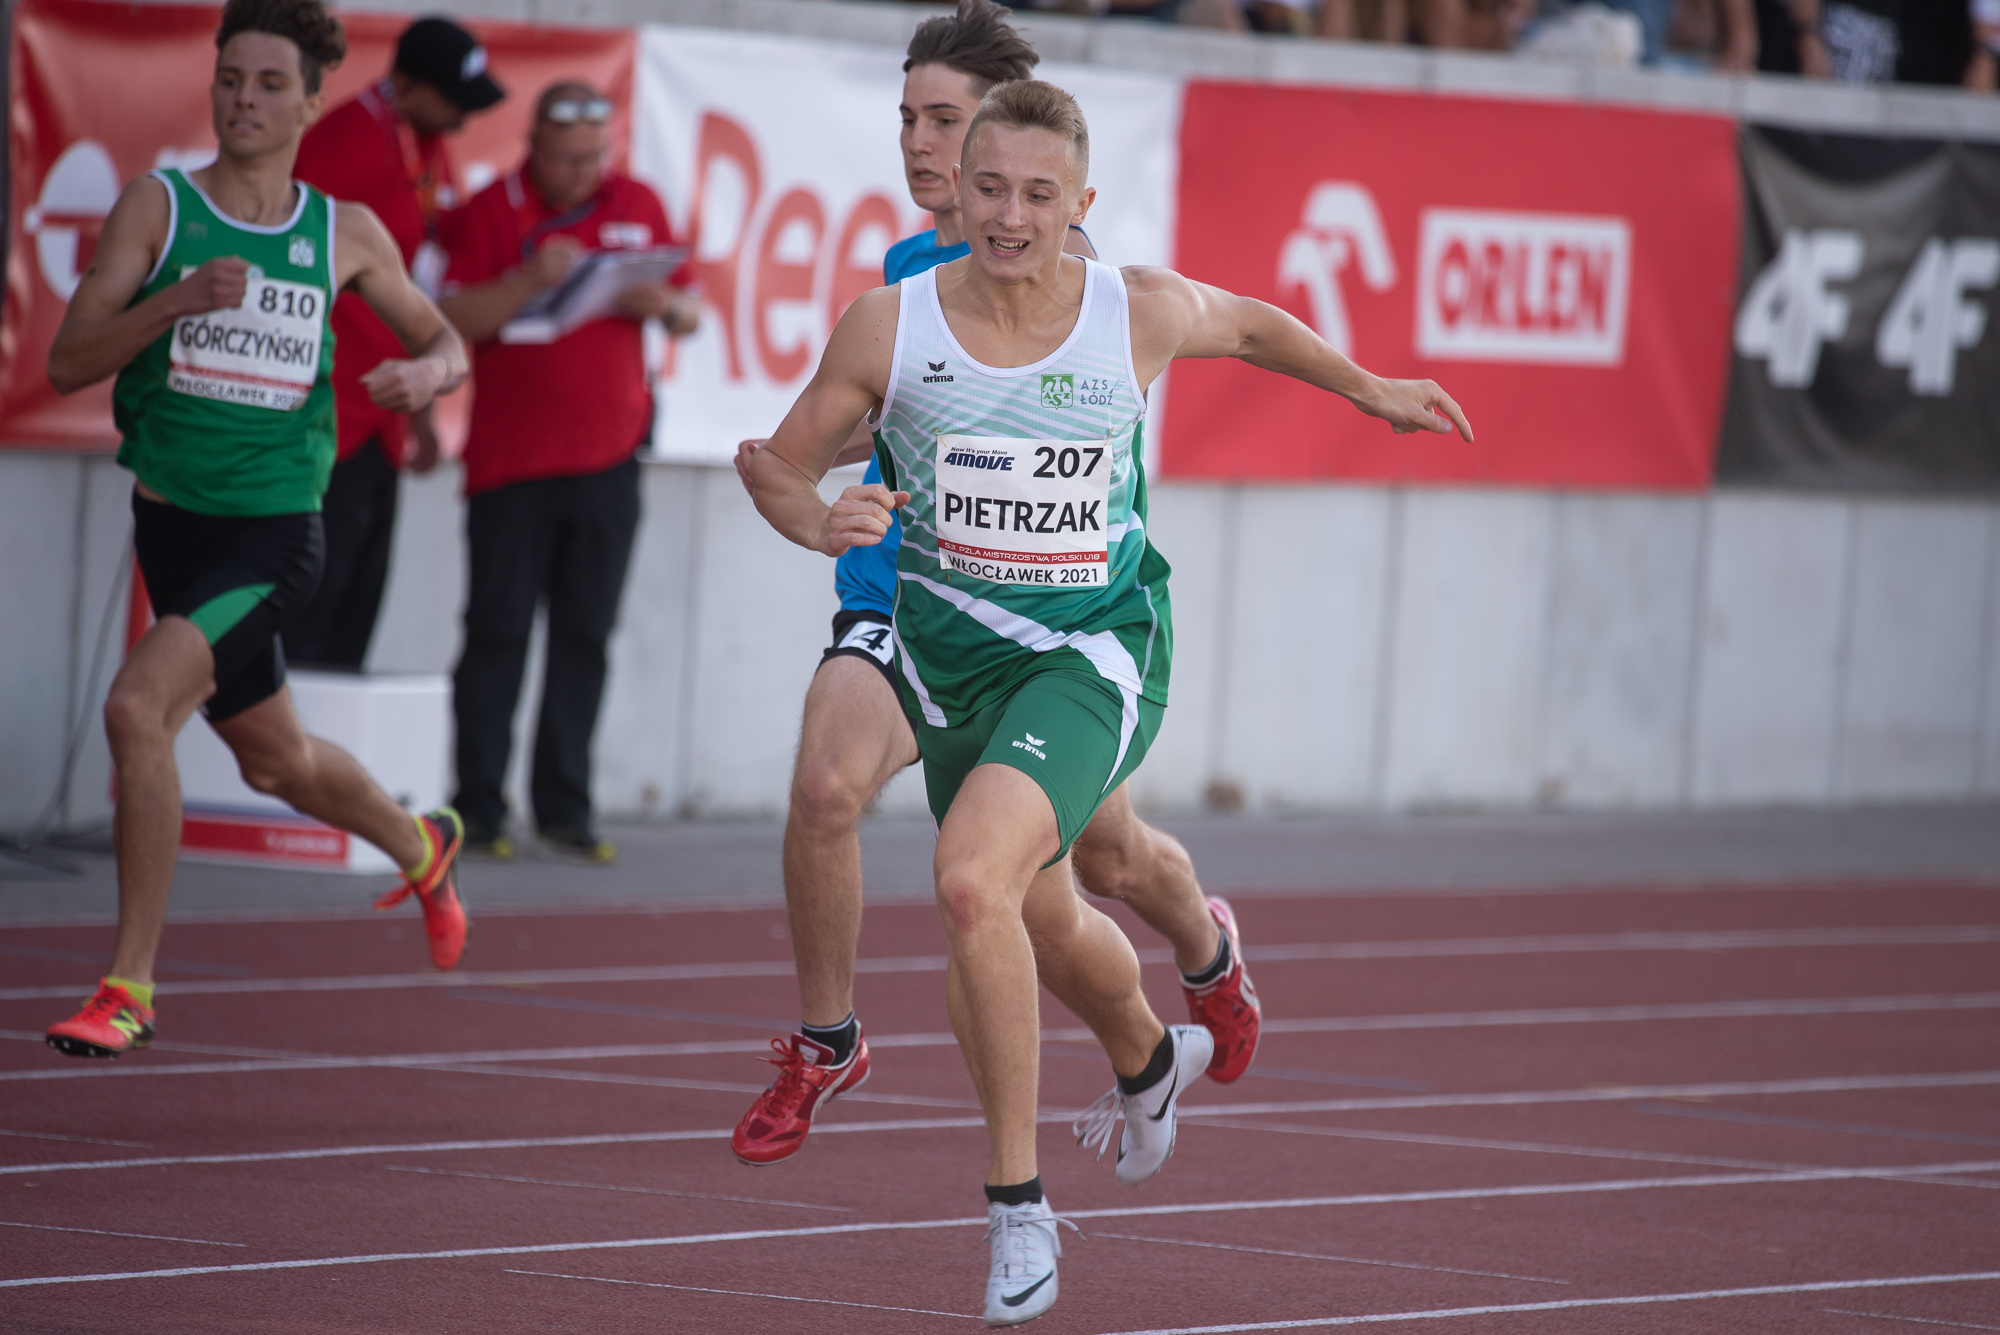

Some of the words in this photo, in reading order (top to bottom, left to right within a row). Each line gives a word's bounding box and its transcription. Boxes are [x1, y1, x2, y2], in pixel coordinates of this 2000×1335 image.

[661, 110, 937, 384] Ree
[1435, 238, 1612, 334] ORLEN
[259, 285, 315, 320] 810
[1735, 228, 1862, 389] 4F
[1875, 236, 2000, 396] 4F
[179, 320, 314, 367] GÓRCZYŃSKI
[923, 374, 954, 383] erima
[1081, 379, 1108, 390] AZS
[1080, 391, 1113, 406] ŁÓDŹ
[944, 452, 1015, 471] 4MOVE
[1033, 447, 1104, 478] 207
[944, 492, 1101, 534] PIETRZAK
[948, 554, 1054, 584] WŁOCŁAWEK
[1060, 568, 1098, 583] 2021
[959, 546, 981, 556] PZLA
[983, 551, 1049, 562] MISTRZOSTWA
[1051, 553, 1082, 562] POLSKI
[852, 628, 891, 652] 4
[1012, 740, 1046, 761] erima
